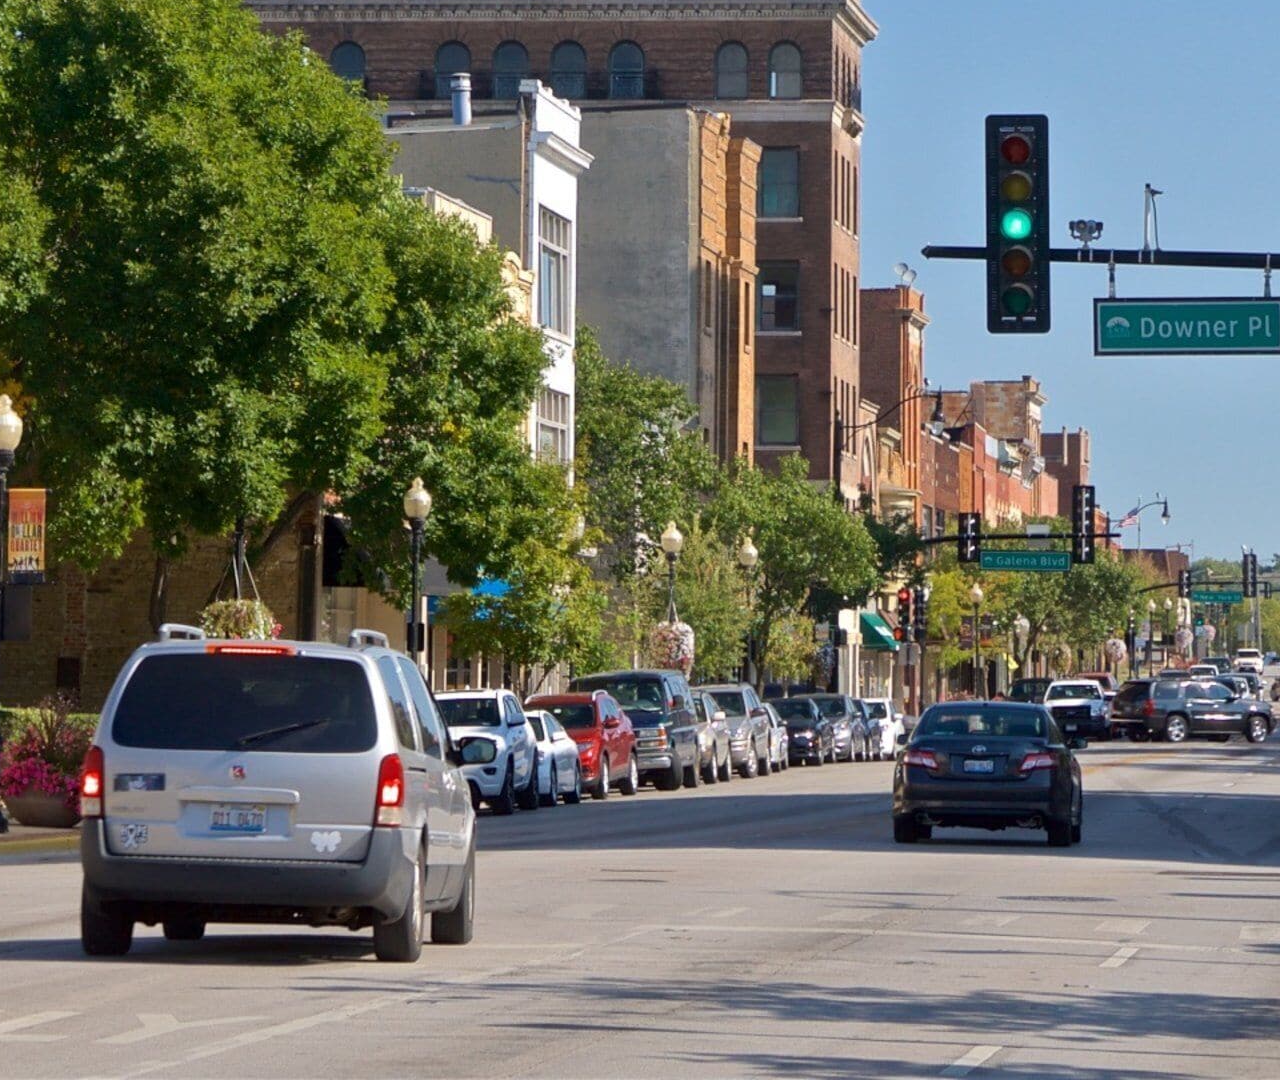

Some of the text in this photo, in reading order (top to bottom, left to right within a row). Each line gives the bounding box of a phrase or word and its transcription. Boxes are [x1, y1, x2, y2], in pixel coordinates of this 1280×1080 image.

[1140, 317, 1238, 338] Downer
[1248, 315, 1272, 338] Pl
[996, 556, 1065, 566] Galena Blvd
